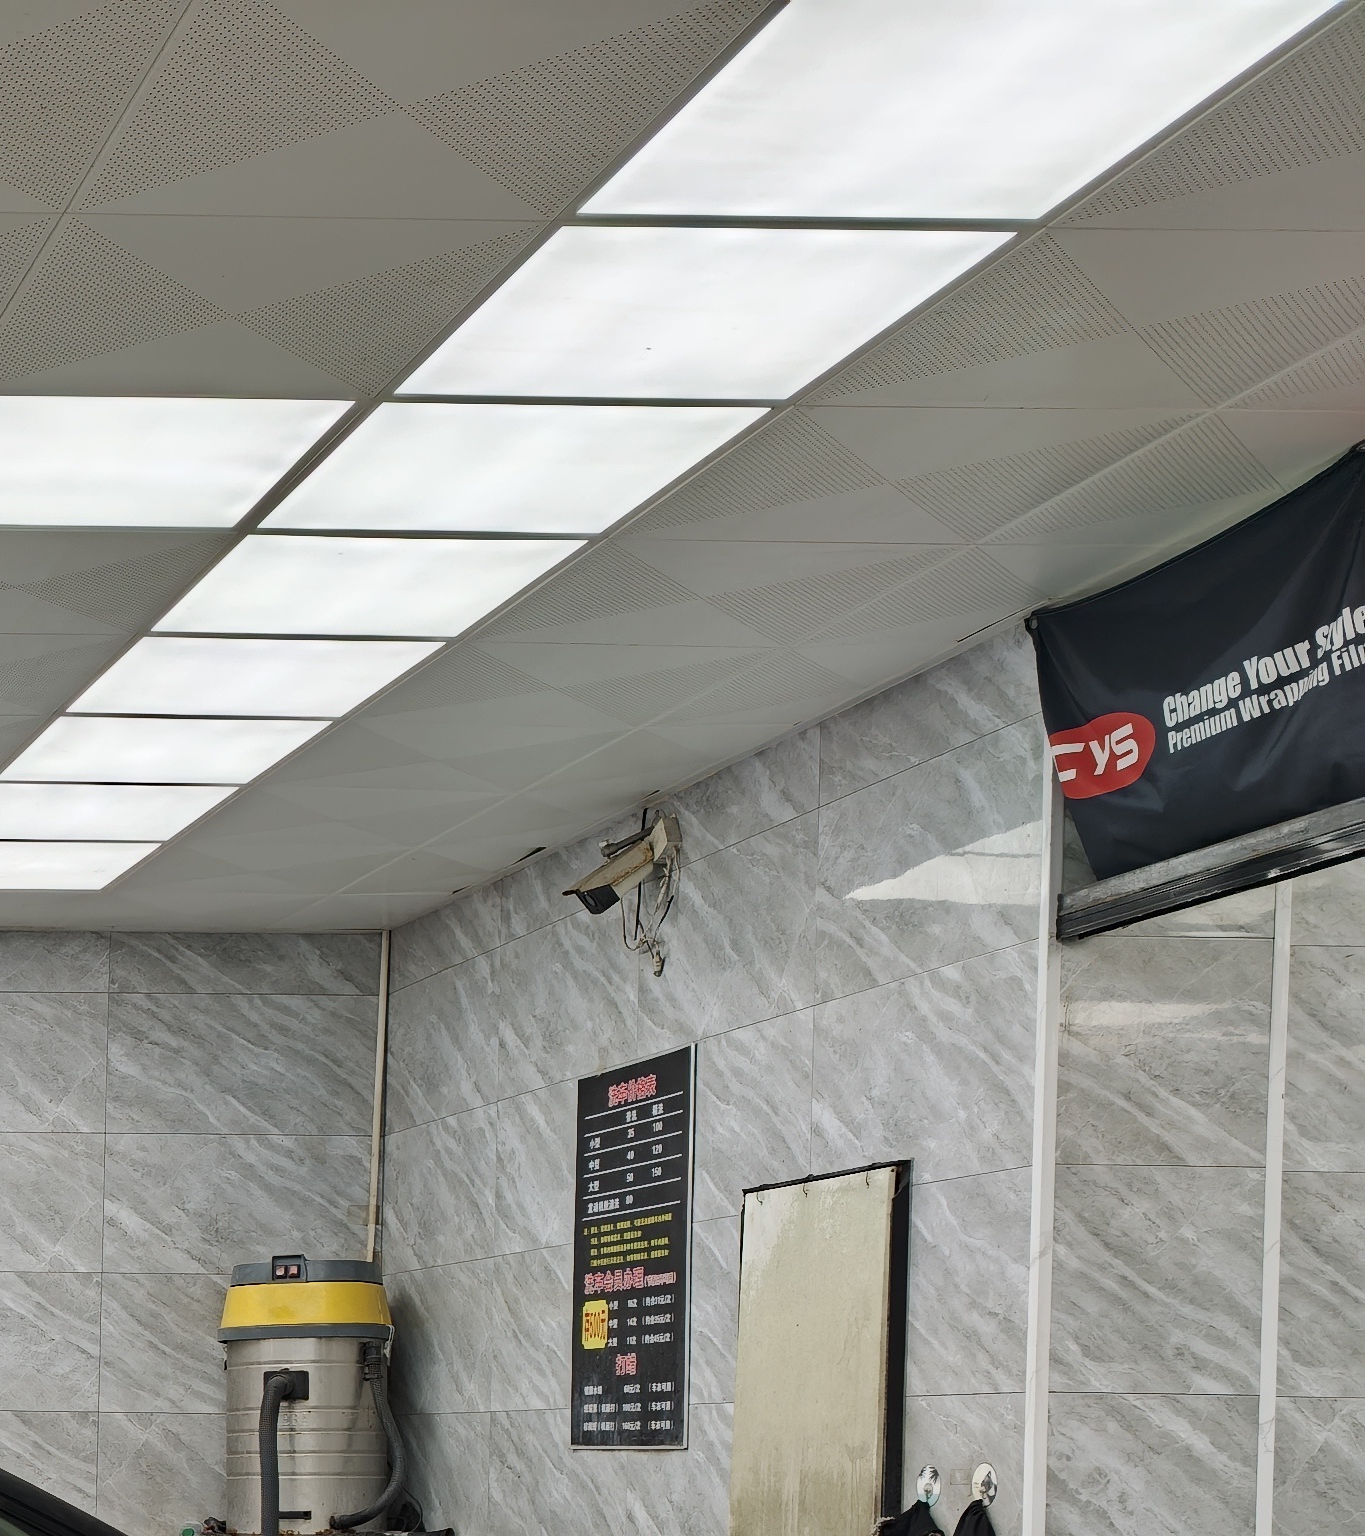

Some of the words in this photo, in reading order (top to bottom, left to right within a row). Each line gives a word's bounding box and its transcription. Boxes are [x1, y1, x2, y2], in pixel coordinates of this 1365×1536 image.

[1163, 671, 1242, 728] Change
[1242, 639, 1311, 691] Your
[1167, 707, 1238, 754] Premium
[1238, 661, 1330, 723] Wrapping
[608, 1074, 657, 1107] 洗车价格表
[589, 1137, 601, 1149] 小型
[627, 1128, 635, 1138] 35
[652, 1121, 663, 1132] 100
[588, 1159, 600, 1171] 中型
[626, 1151, 634, 1160] 40
[652, 1144, 662, 1155] 120
[588, 1180, 600, 1192] 大型
[626, 1173, 634, 1182] 50
[651, 1167, 662, 1177] 150
[584, 1266, 644, 1295] 洗车会员办理
